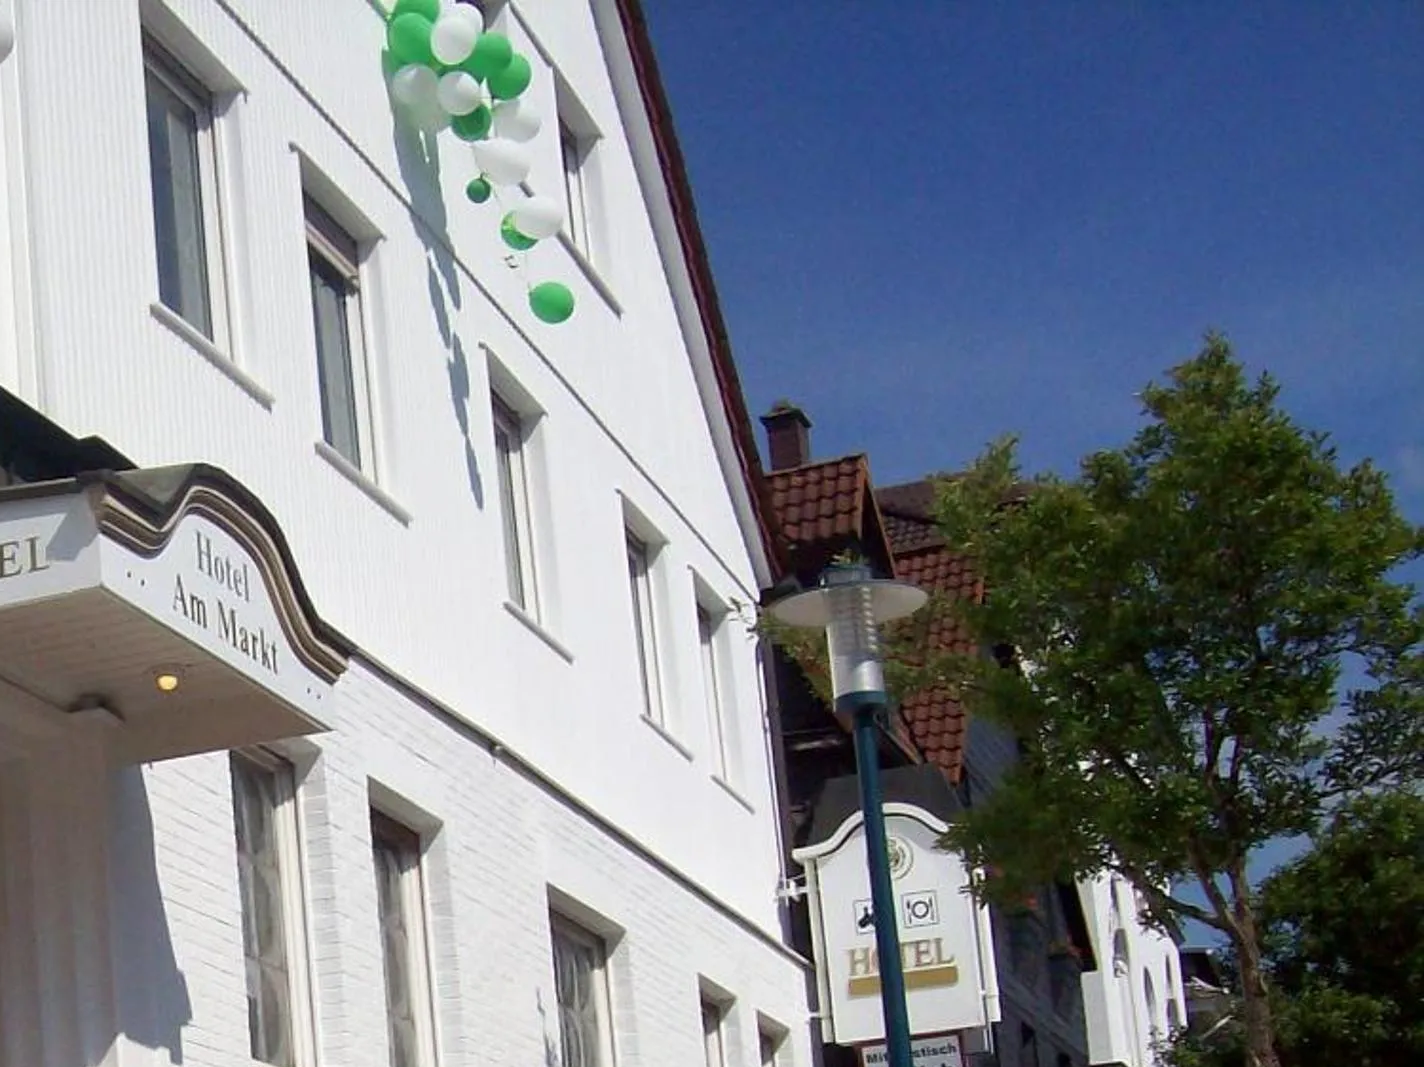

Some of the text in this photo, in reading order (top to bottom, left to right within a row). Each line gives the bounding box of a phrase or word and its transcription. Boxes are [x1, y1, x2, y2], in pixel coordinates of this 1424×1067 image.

[195, 530, 250, 603] Hotel
[172, 573, 279, 675] Am Markt
[865, 1042, 957, 1064] Mitstisch
